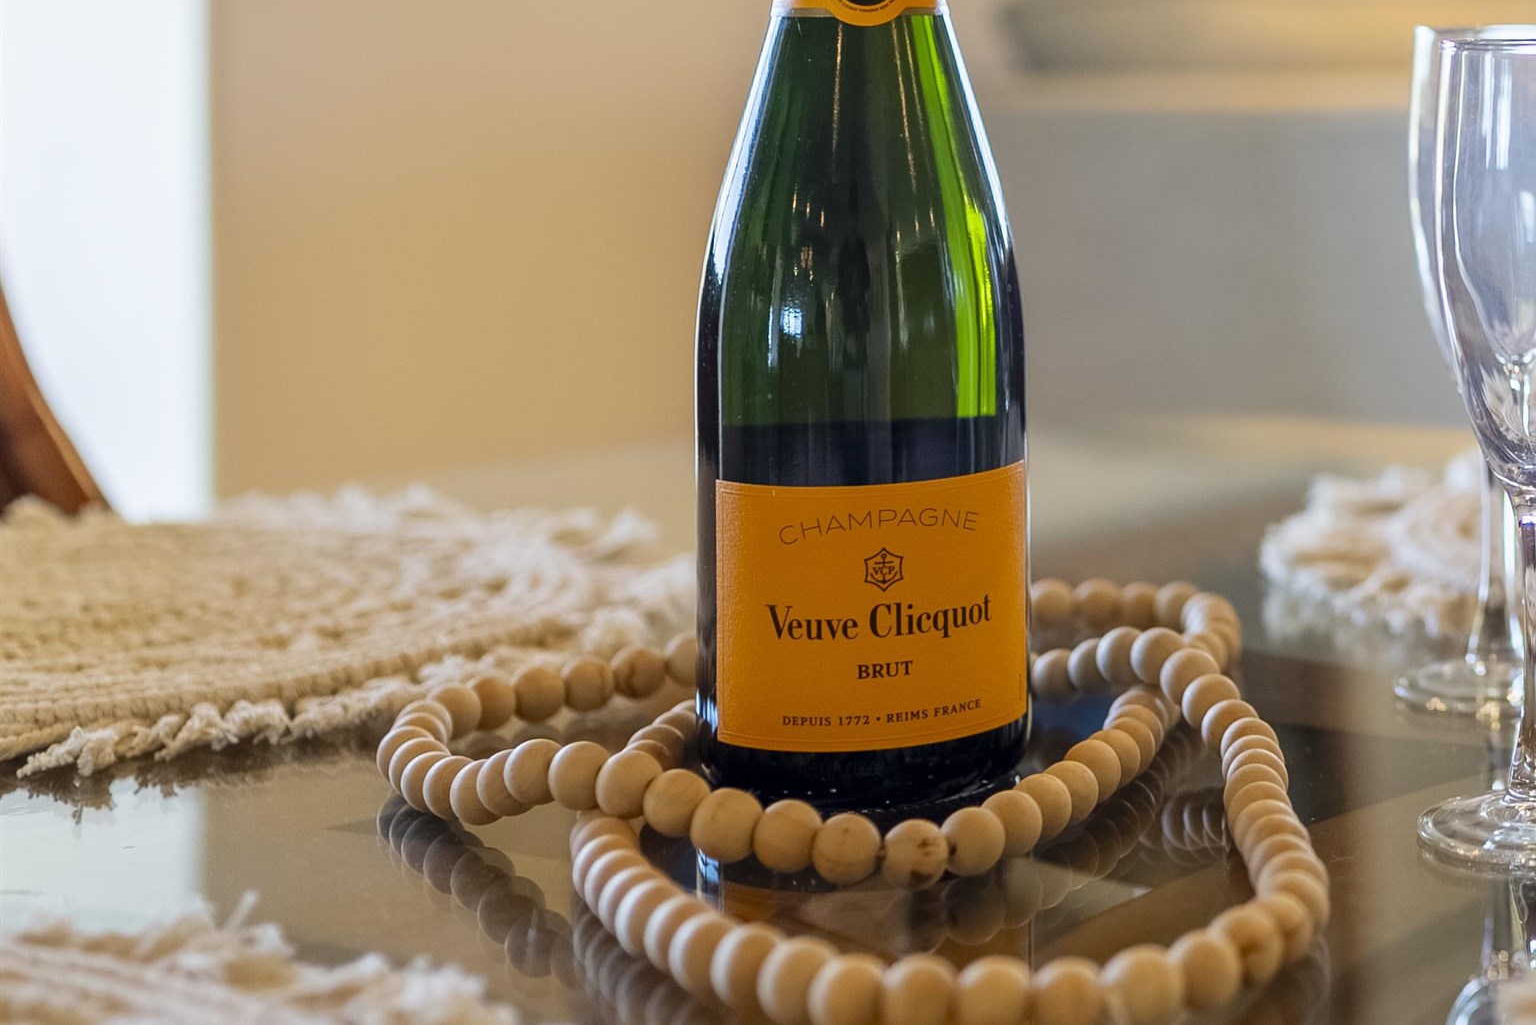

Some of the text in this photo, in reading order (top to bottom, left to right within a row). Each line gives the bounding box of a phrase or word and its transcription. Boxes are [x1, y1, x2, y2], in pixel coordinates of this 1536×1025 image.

[778, 507, 979, 545] CHAMPAGNE
[872, 566, 895, 576] VCP
[765, 594, 992, 641] Veuve Clicquot
[857, 660, 913, 680] BRUT
[782, 698, 982, 727] DEPUIS 1772 REIMS FRANCE
